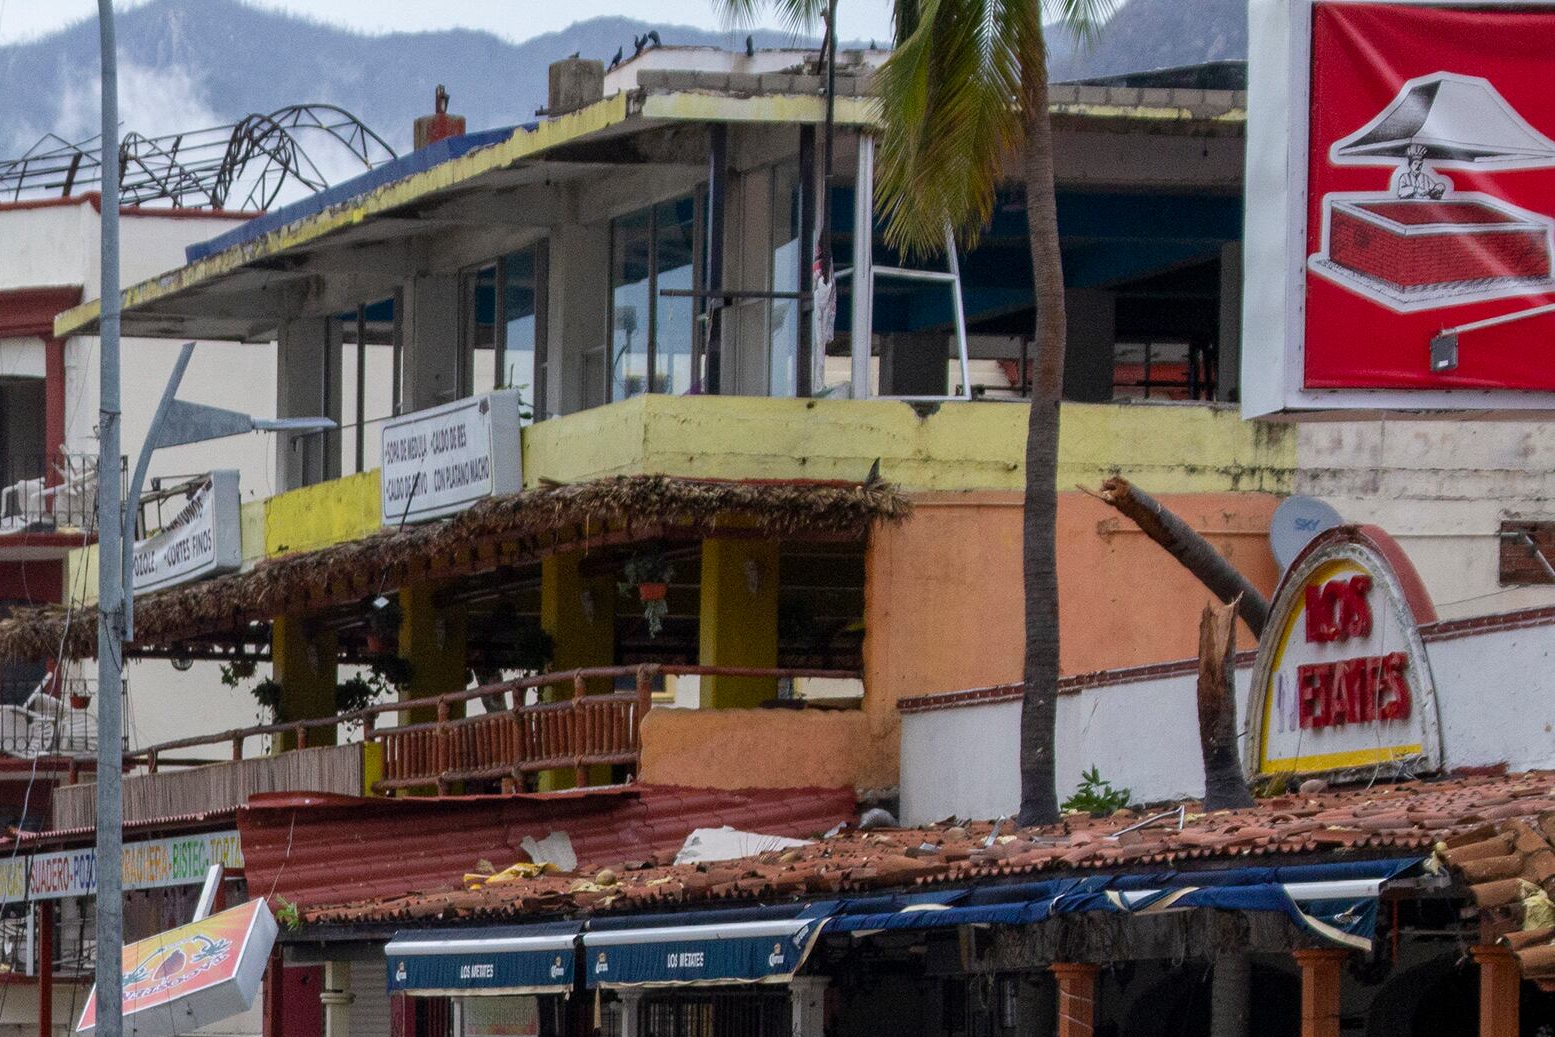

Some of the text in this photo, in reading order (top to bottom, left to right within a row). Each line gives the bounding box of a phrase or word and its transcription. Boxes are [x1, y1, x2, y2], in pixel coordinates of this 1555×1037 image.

[1295, 517, 1320, 532] SKY
[167, 538, 191, 568] CORTES
[192, 528, 212, 559] FINOS
[1305, 575, 1374, 643] LOS
[667, 954, 678, 968] LOS
[460, 965, 471, 979] LOS
